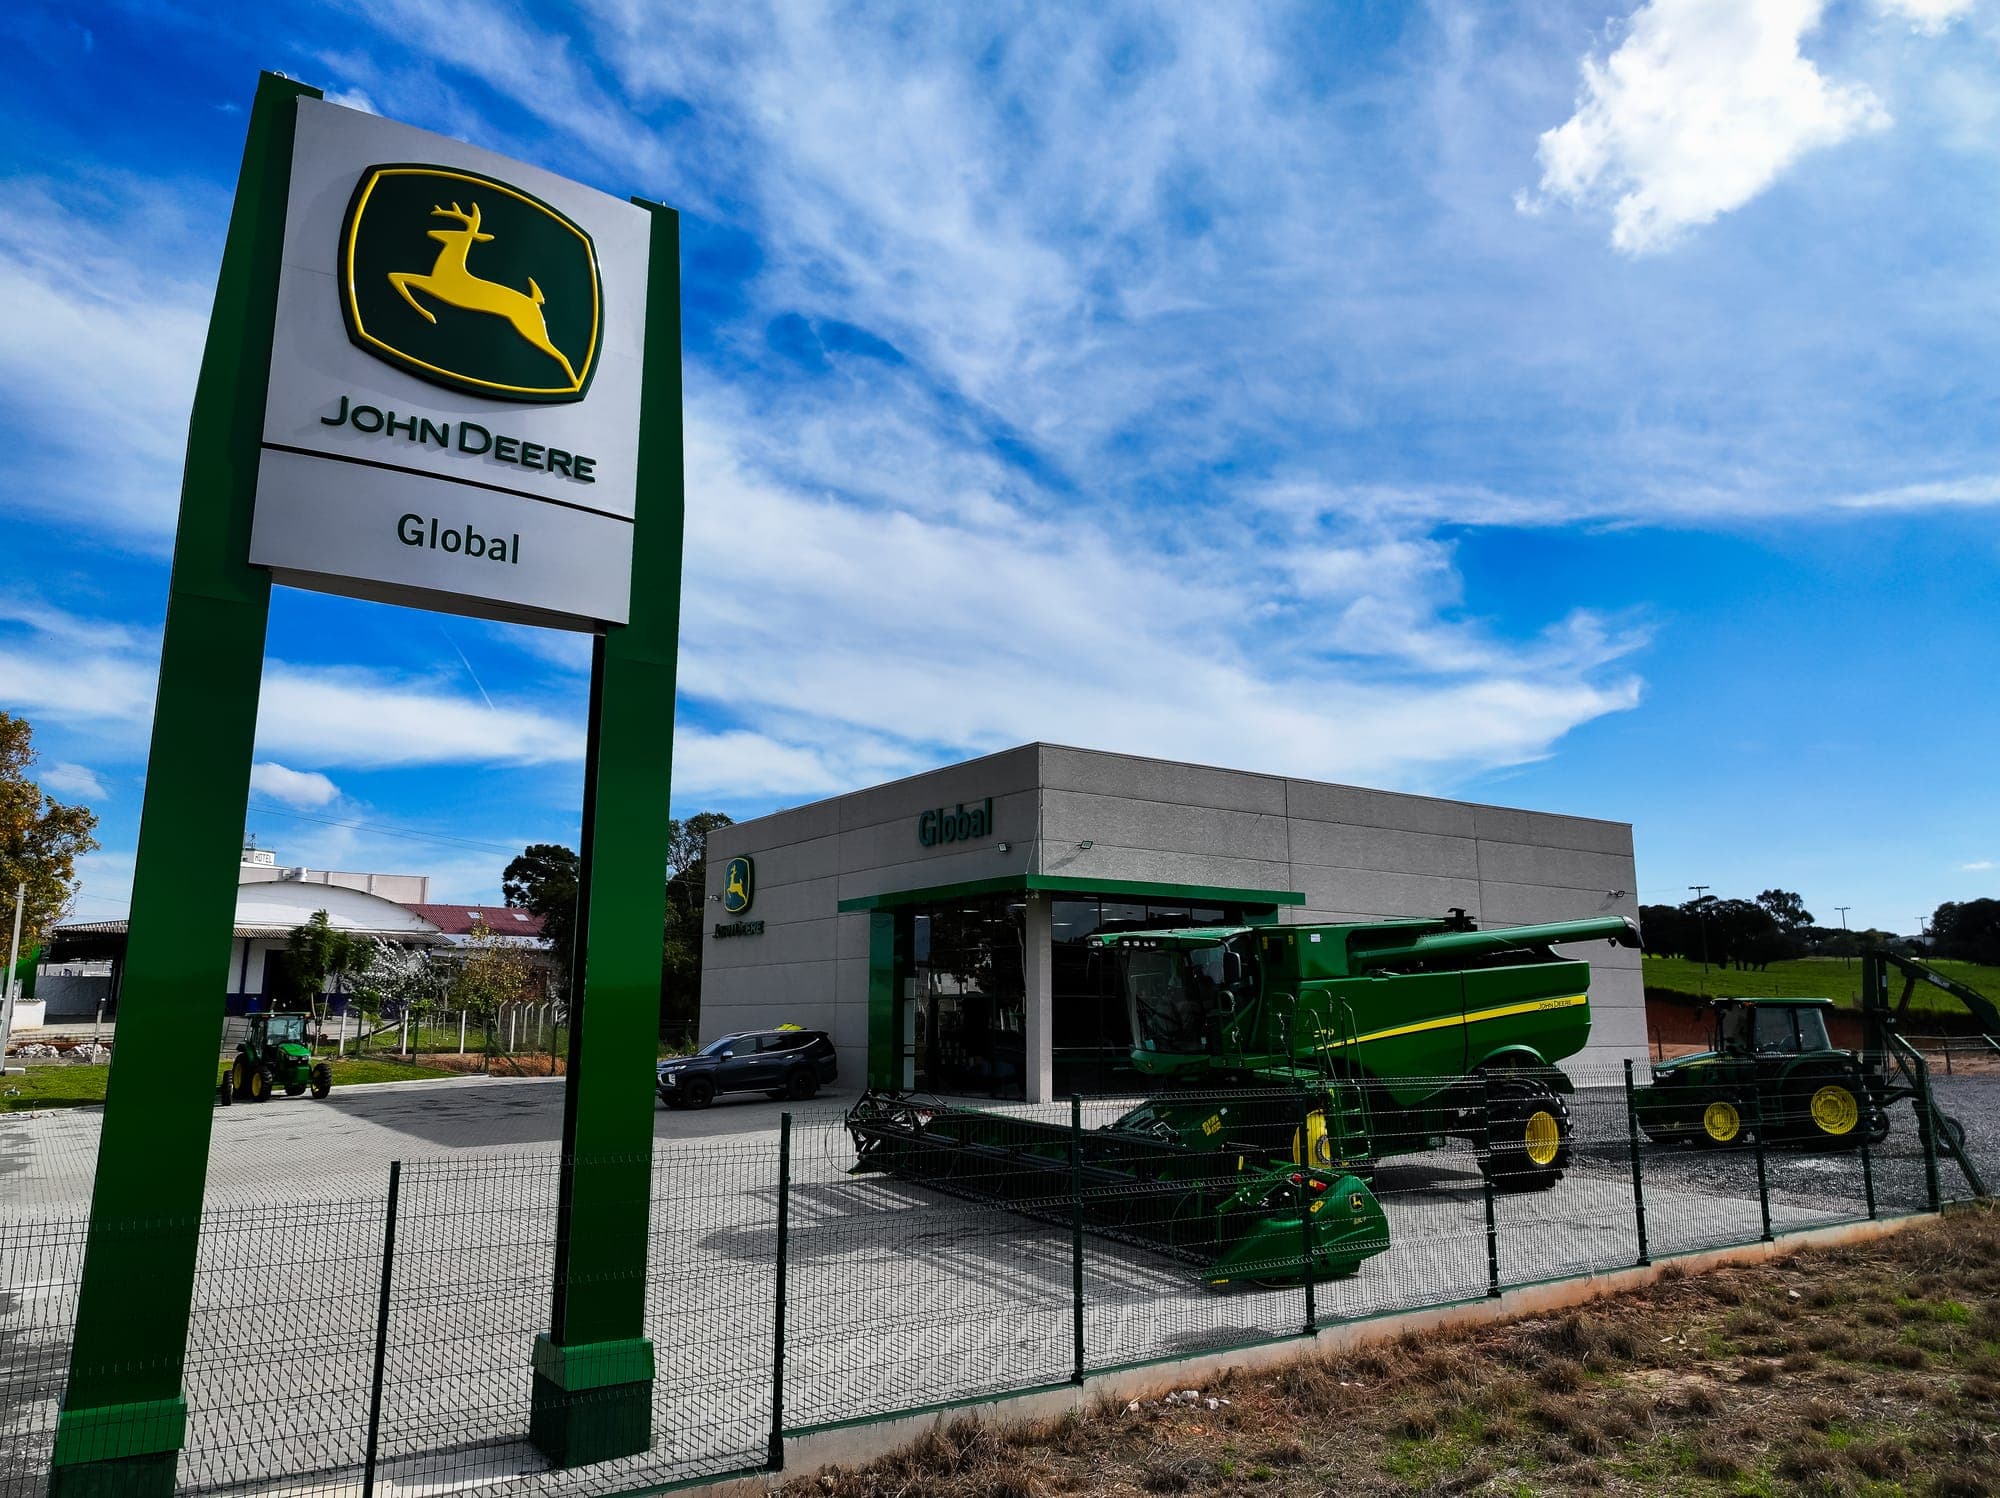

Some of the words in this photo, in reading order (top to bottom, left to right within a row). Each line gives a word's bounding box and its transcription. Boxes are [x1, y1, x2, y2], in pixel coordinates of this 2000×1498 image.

[320, 396, 449, 448] JOHN
[459, 422, 597, 483] DEERE
[398, 513, 519, 564] Global
[919, 797, 992, 847] Global
